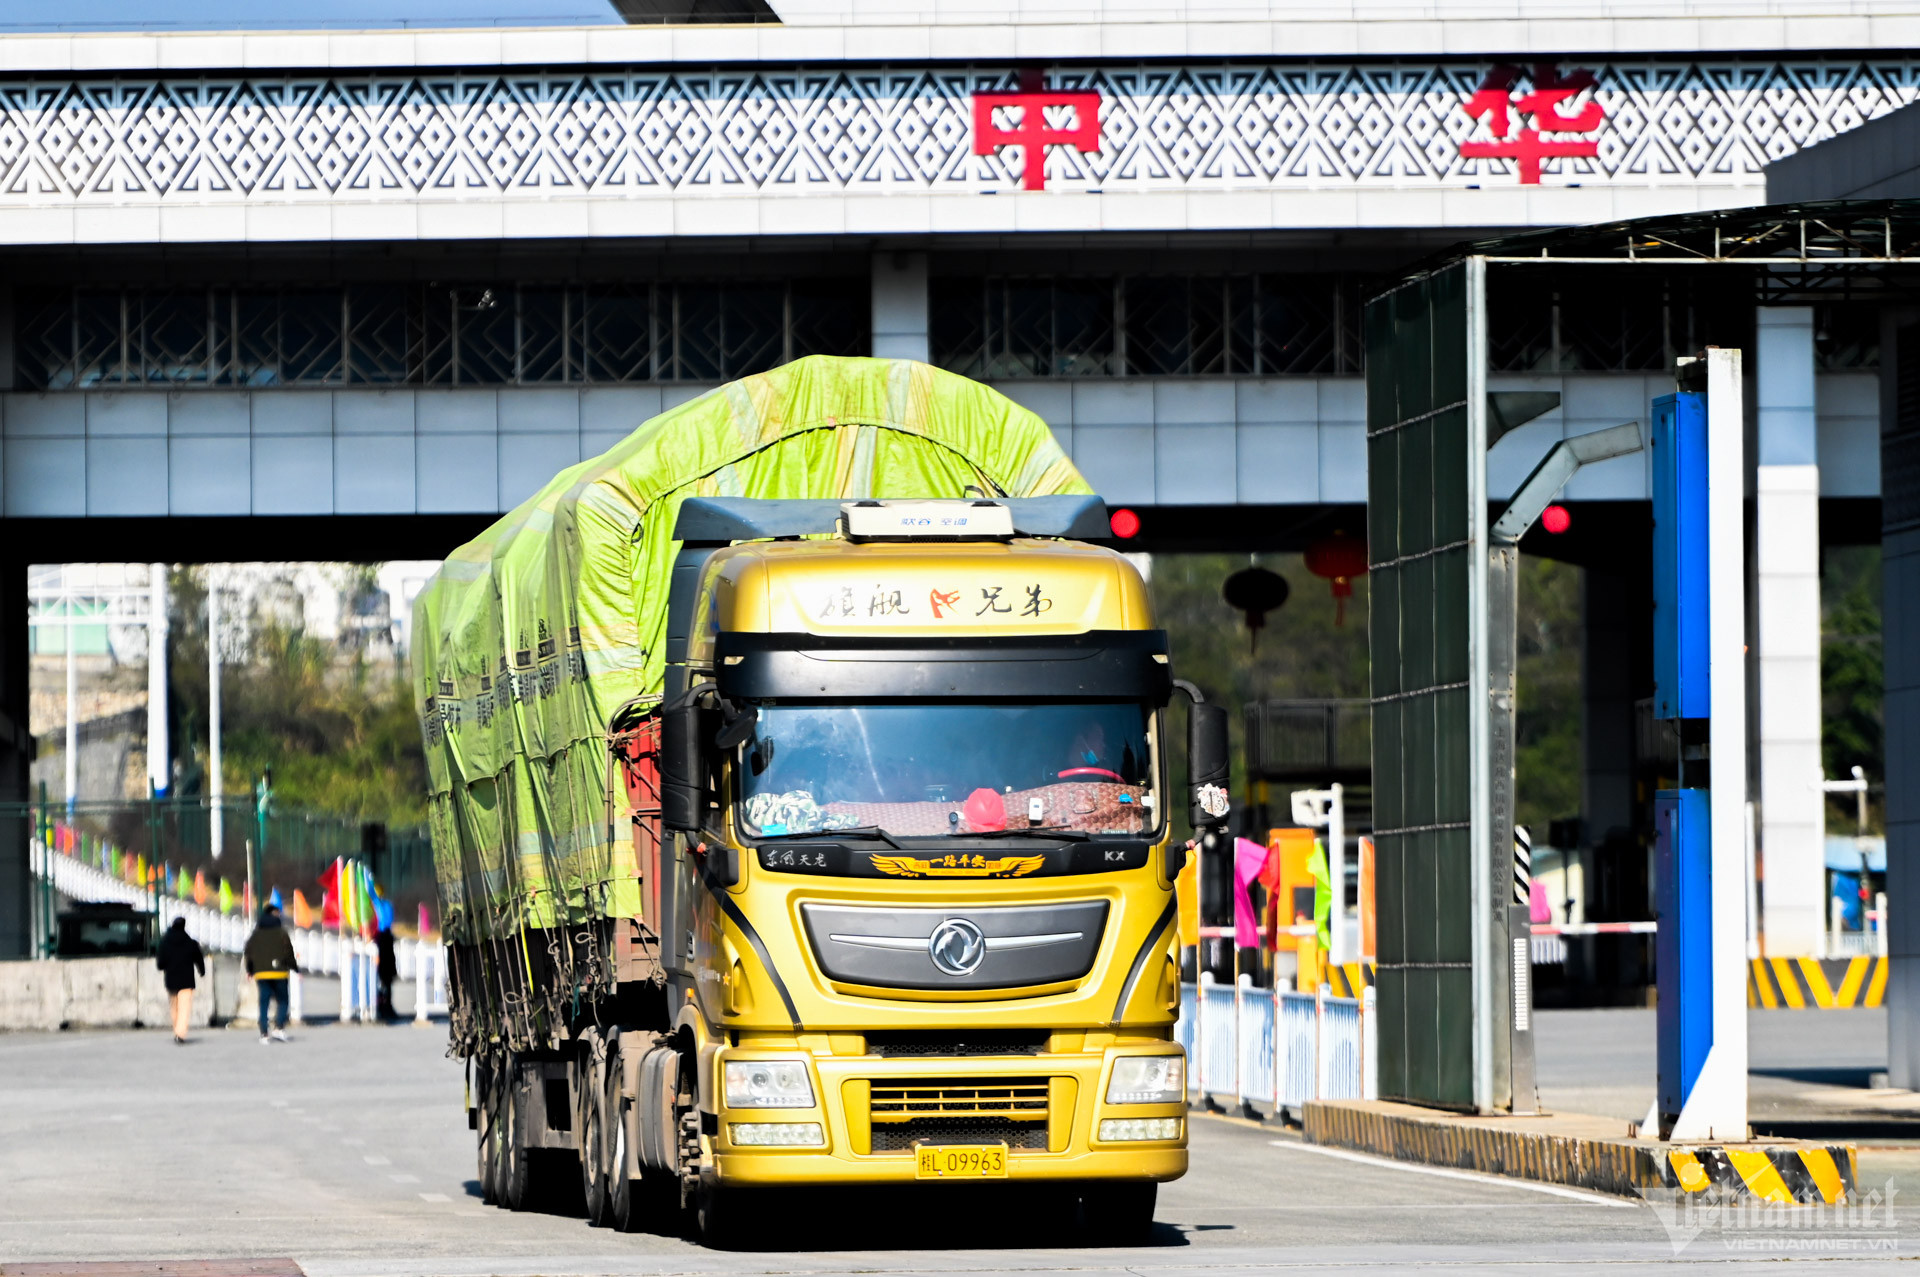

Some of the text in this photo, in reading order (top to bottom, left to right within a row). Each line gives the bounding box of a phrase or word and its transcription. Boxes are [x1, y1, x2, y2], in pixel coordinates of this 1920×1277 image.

[971, 62, 1605, 191] 中 华
[819, 583, 1053, 618] 旗舰 兄弟
[765, 849, 827, 868] 东风天龙
[929, 853, 987, 868] 一路平安
[1104, 850, 1126, 861] KX
